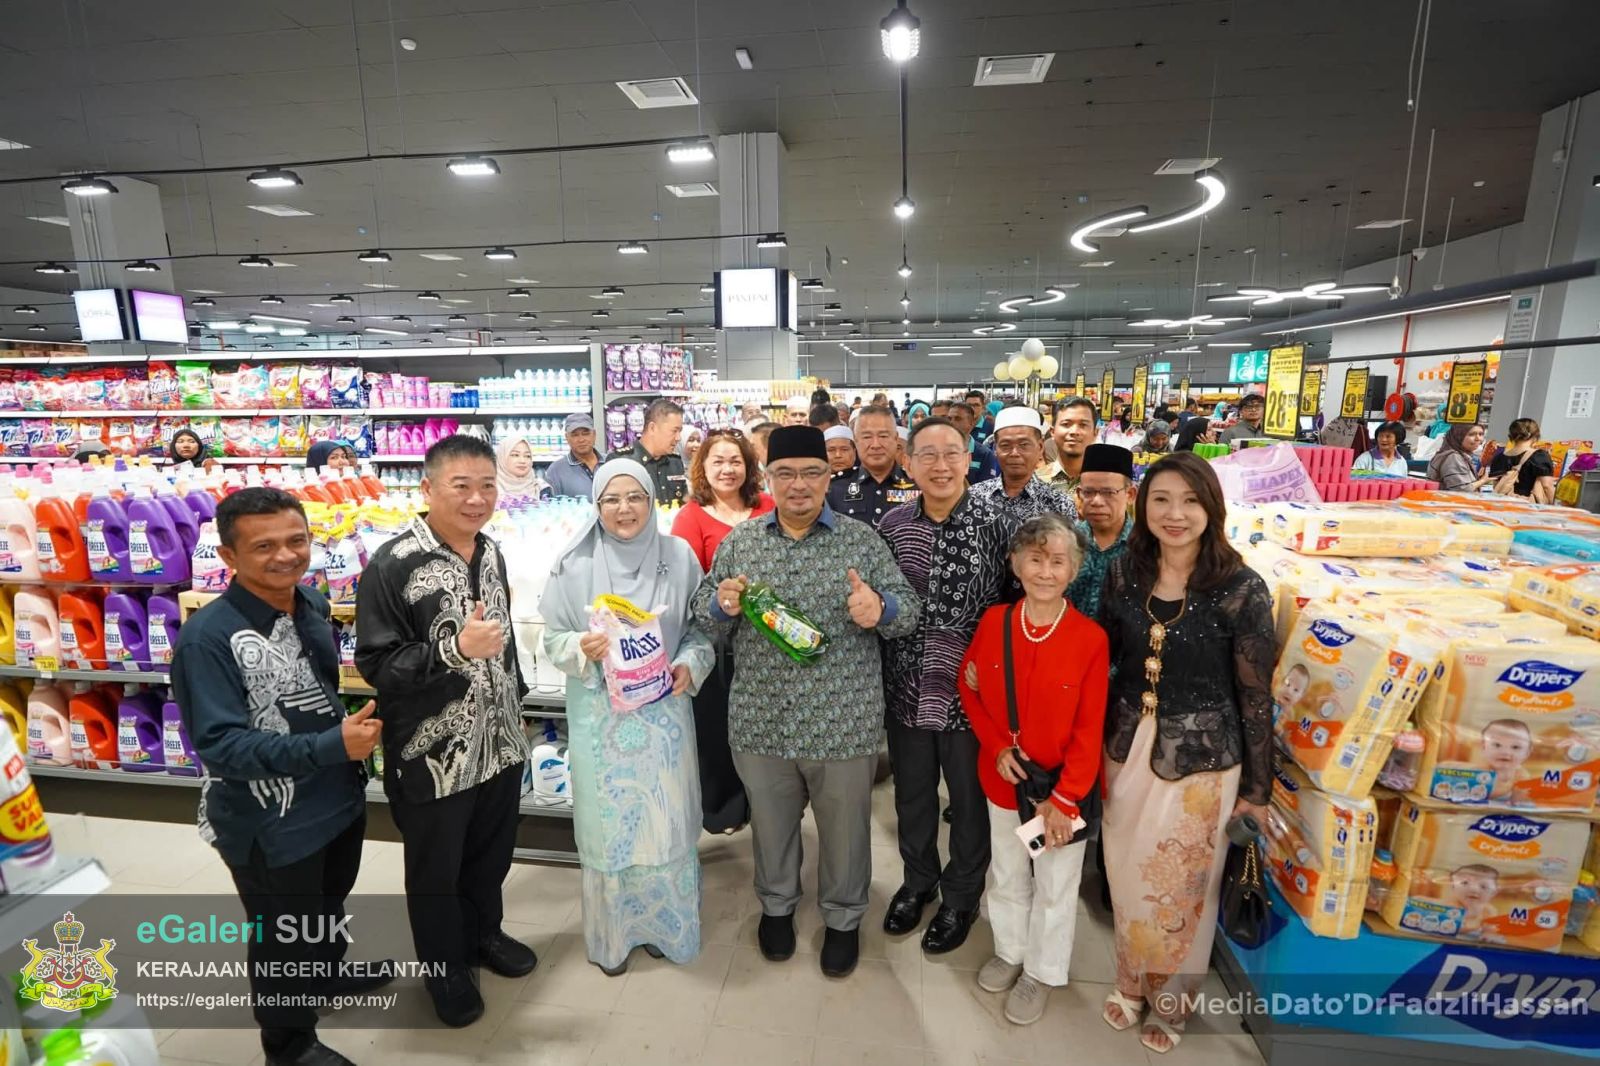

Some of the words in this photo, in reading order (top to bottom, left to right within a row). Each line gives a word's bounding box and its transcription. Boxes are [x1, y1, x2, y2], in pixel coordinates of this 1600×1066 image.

[1266, 390, 1287, 428] 28
[1344, 392, 1357, 413] 9
[1450, 392, 1469, 418] 8
[1314, 620, 1351, 645] Drypers
[1508, 666, 1574, 687] Drypers
[1543, 769, 1561, 783] M
[1479, 817, 1541, 837] Drypers
[1510, 907, 1528, 920] M
[1424, 953, 1600, 1019] Dryp
